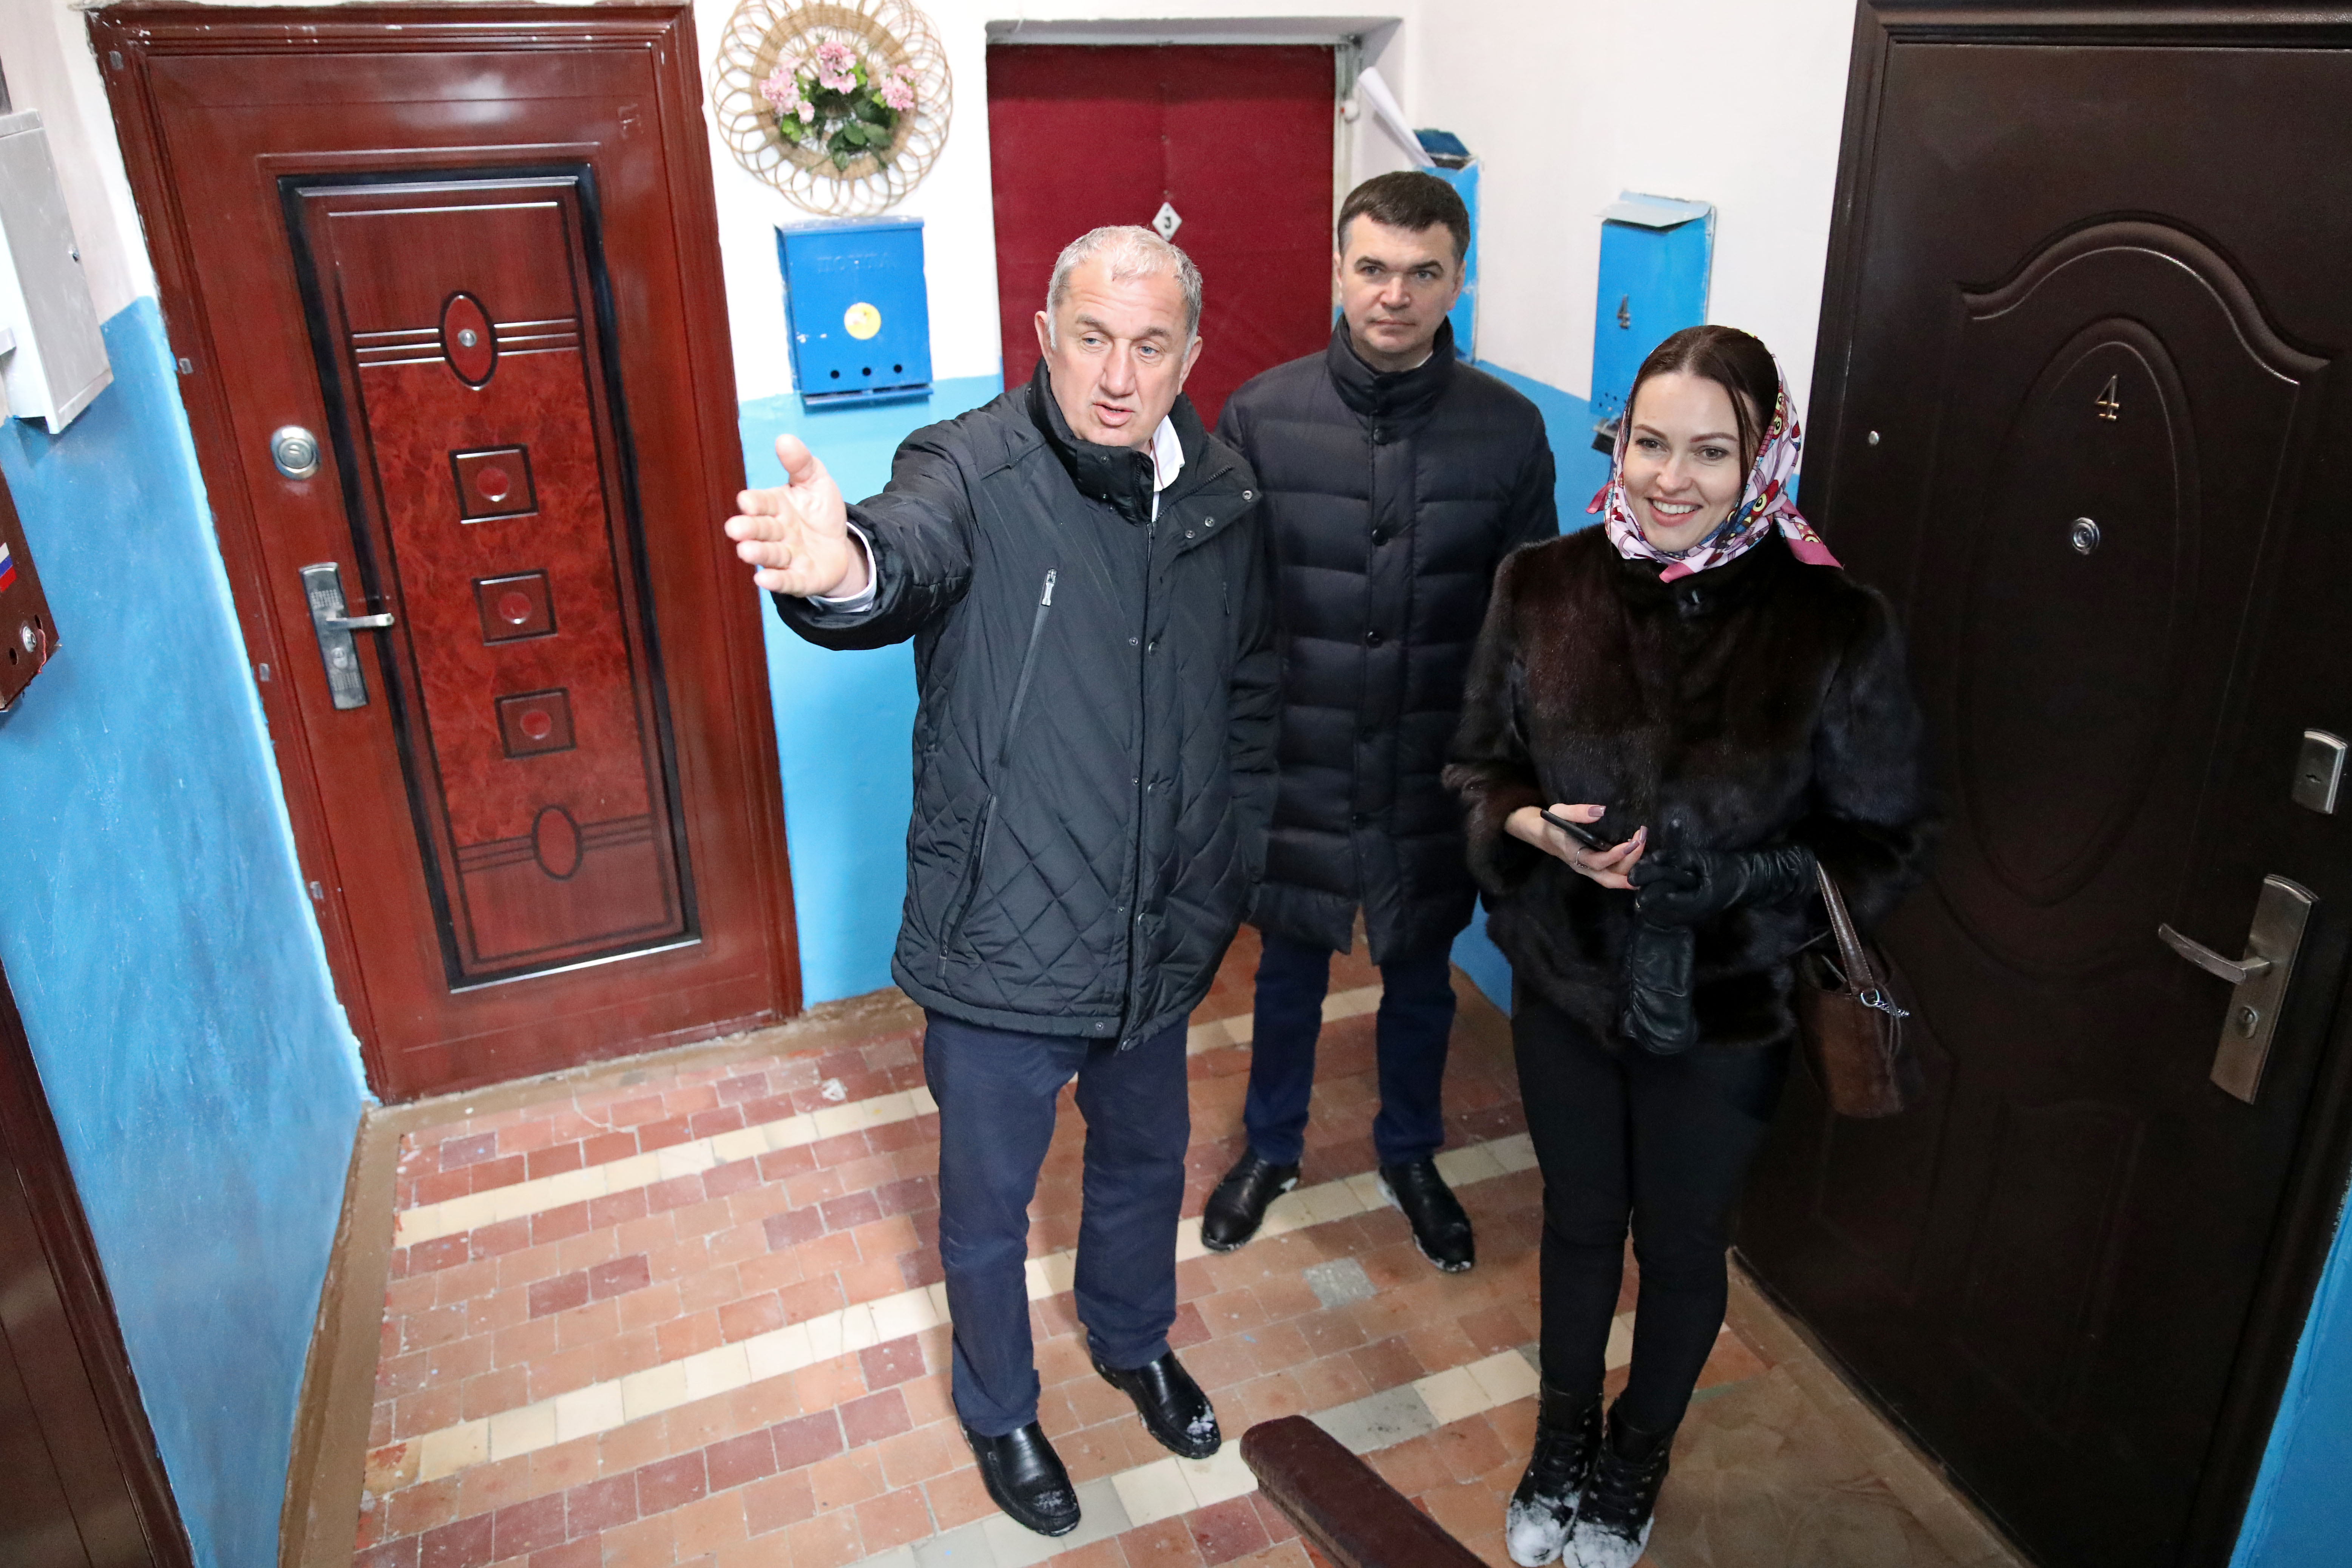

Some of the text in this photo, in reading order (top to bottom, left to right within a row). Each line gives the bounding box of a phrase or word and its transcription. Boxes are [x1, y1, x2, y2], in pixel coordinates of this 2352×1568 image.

[1163, 216, 1172, 229] 3
[1617, 294, 1631, 329] 4
[2094, 374, 2120, 422] 4
